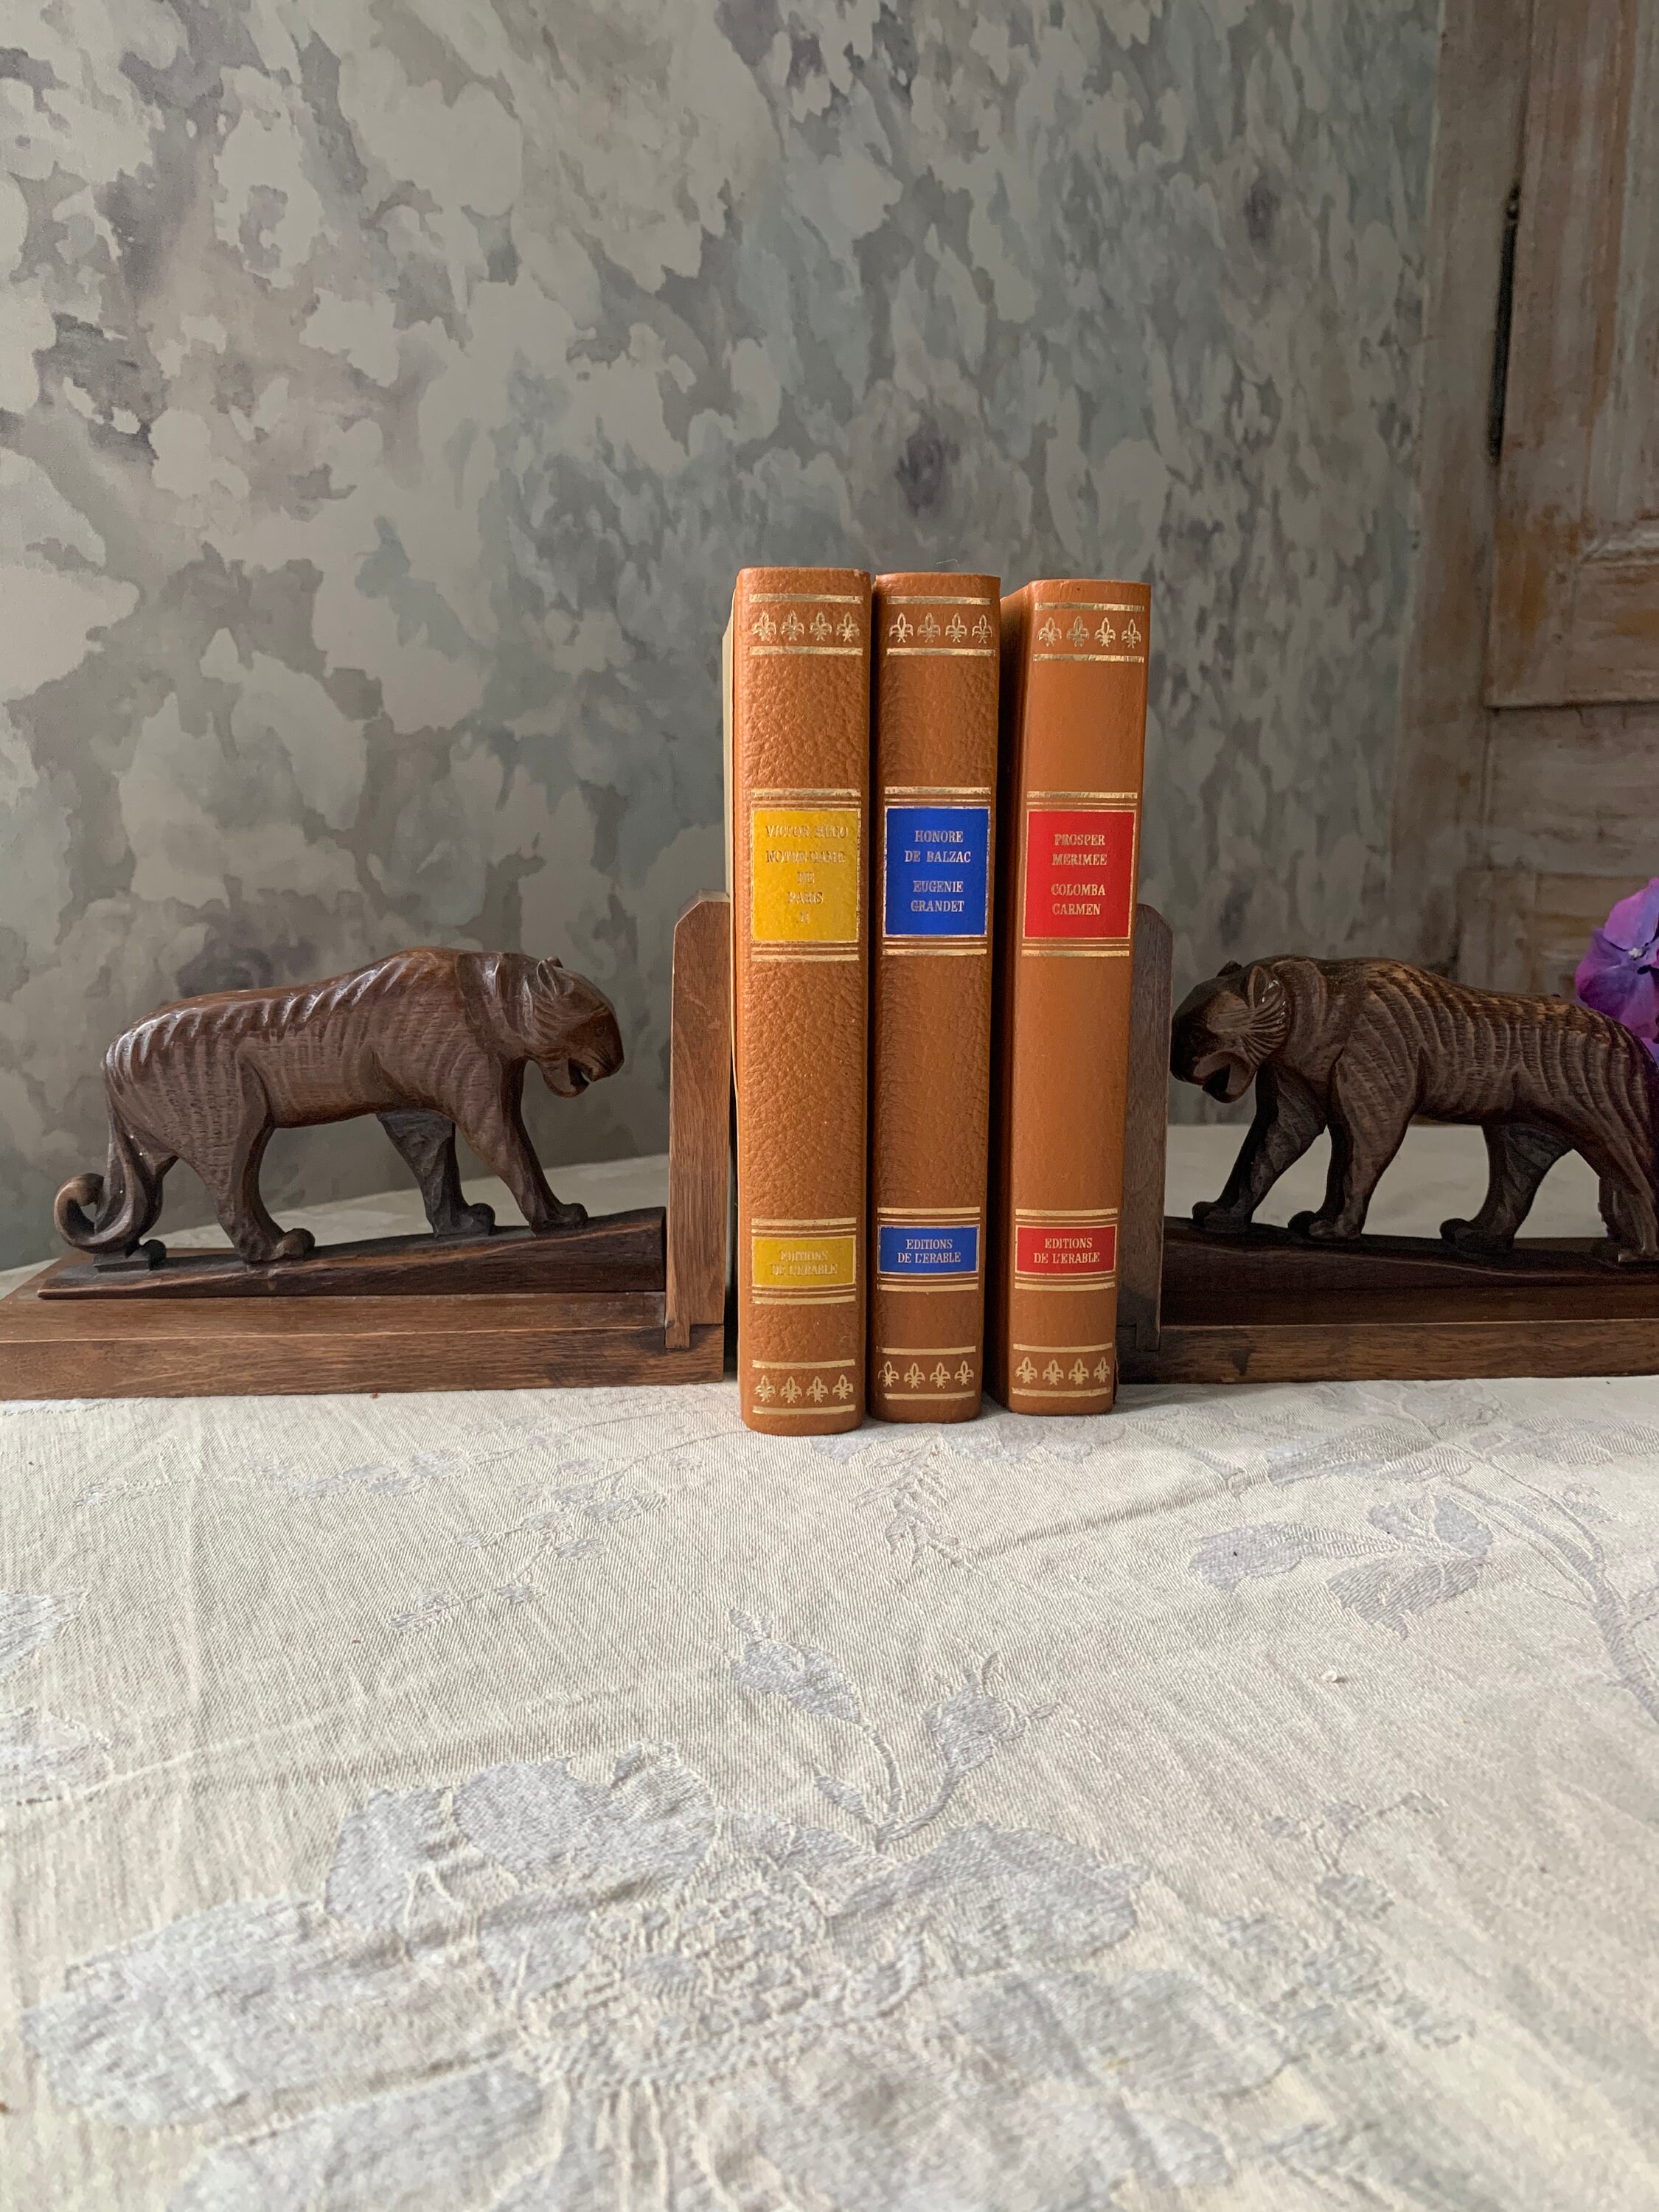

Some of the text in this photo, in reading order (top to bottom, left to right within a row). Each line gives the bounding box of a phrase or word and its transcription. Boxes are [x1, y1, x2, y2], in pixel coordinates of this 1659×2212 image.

[765, 825, 849, 838] VICTOR HUGO
[914, 830, 964, 843] HONORE
[1054, 834, 1106, 846] PROSPER
[904, 850, 971, 863] DE BALZAC
[1051, 854, 1107, 866] MERIMEE
[797, 872, 815, 883] DE
[913, 880, 964, 893] EUGENIE
[1051, 884, 1106, 897] COLOMBA
[787, 891, 824, 904] PARIS
[911, 900, 964, 913] GRANDET
[1052, 903, 1102, 916] CARMEN
[905, 1239, 953, 1250] EDITIONS
[1045, 1237, 1093, 1249] EDITIONS
[779, 1251, 829, 1262] EDITIONS
[897, 1252, 961, 1264] DE L'ERABLE
[1034, 1252, 1100, 1264] DE L'ERABLE
[771, 1264, 785, 1275] DE
